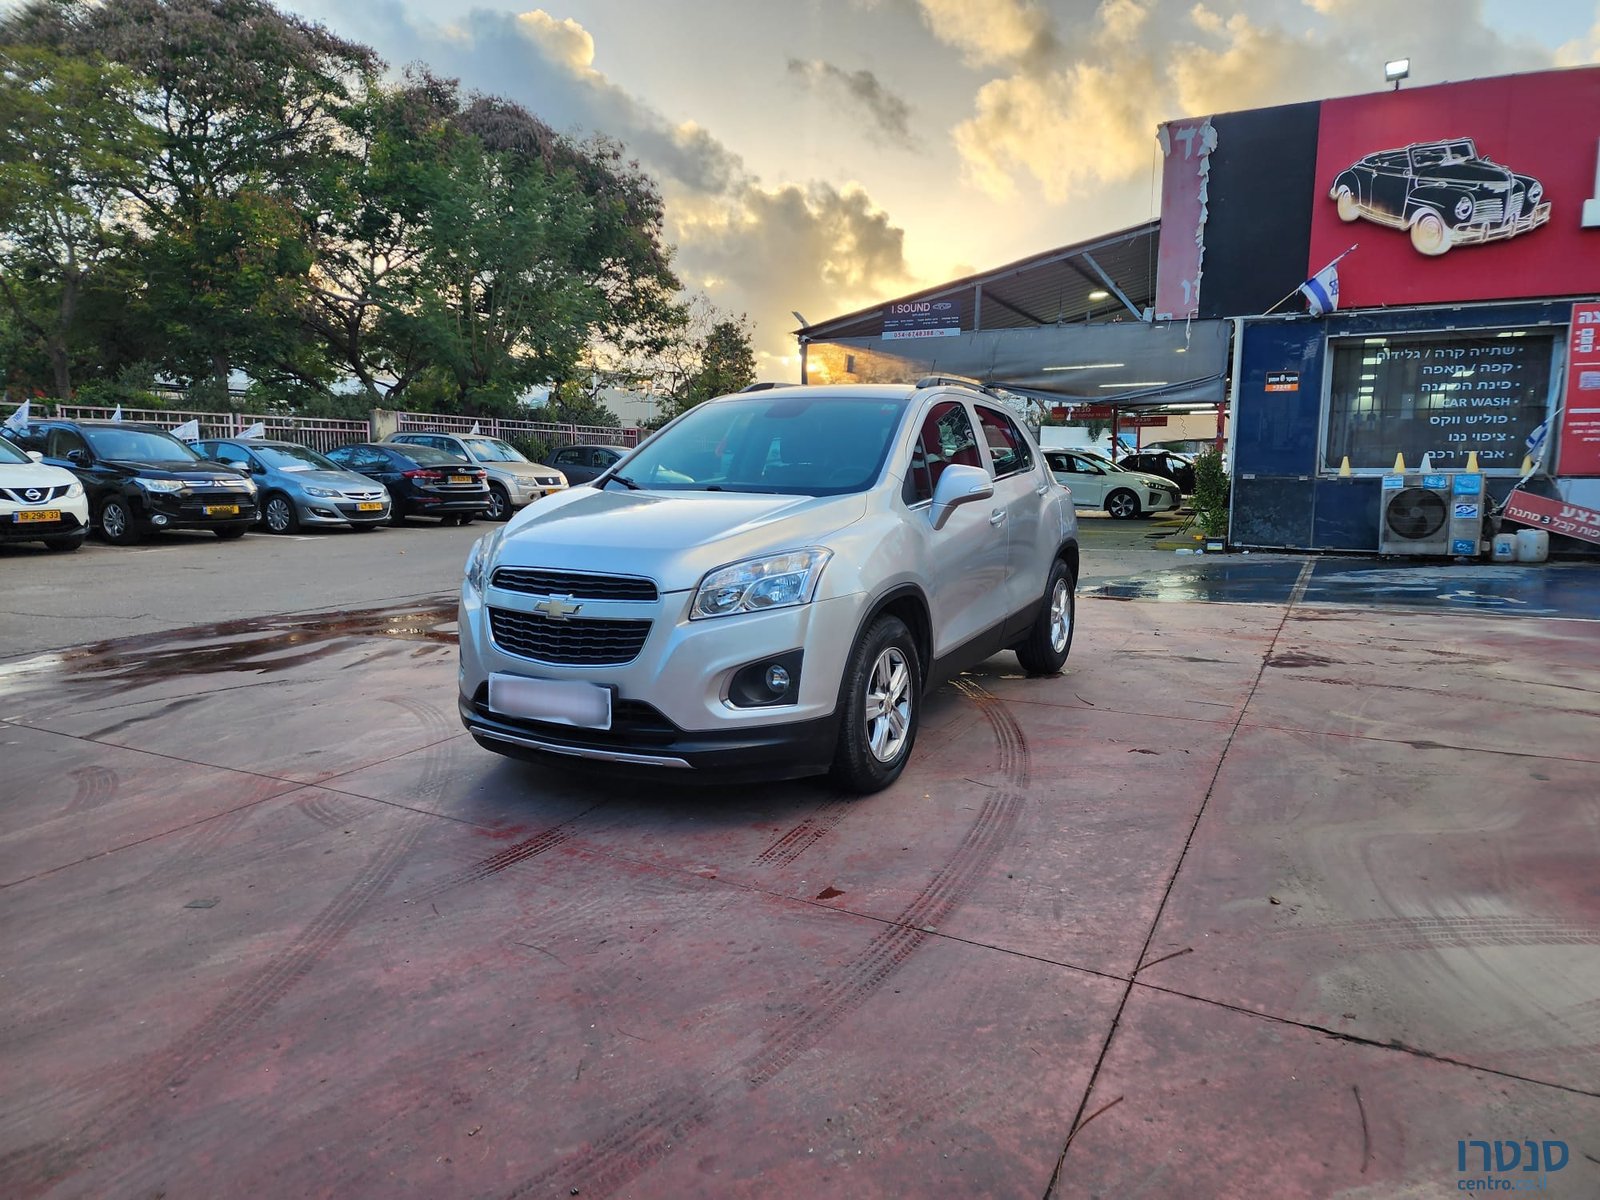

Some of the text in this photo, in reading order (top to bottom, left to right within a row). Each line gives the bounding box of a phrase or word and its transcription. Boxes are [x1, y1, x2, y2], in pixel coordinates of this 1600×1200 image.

[891, 303, 931, 314] I.SOUND
[1434, 348, 1465, 359] קרה
[1470, 346, 1515, 357] שתייה
[1423, 364, 1466, 374] מאפה
[1480, 363, 1514, 374] קפה
[1476, 381, 1512, 390] פינת
[1443, 397, 1511, 407] CAR WASH
[1429, 413, 1508, 426] פוליש ווקס
[1448, 433, 1507, 441] ציפוי ננו
[1508, 507, 1541, 521] מתנה
[1542, 516, 1550, 524] 3
[1552, 517, 1577, 532] קבל
